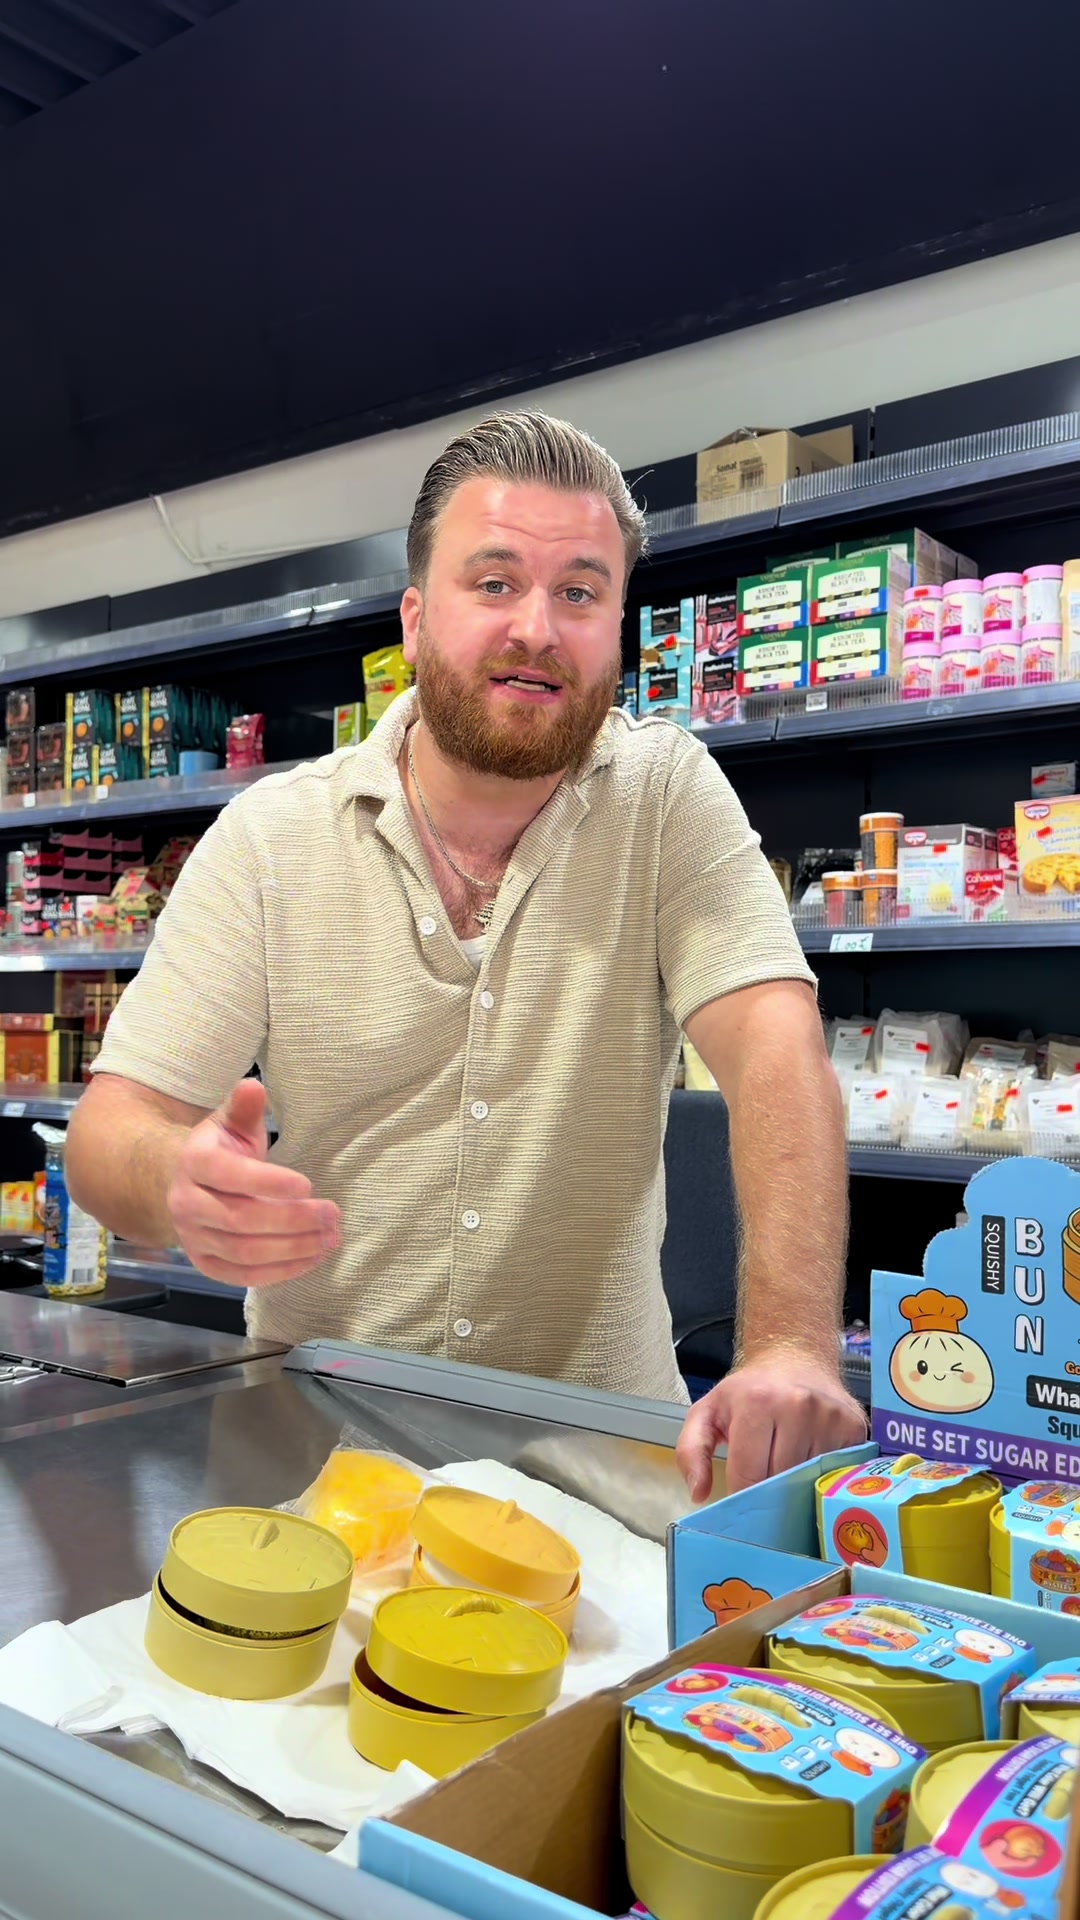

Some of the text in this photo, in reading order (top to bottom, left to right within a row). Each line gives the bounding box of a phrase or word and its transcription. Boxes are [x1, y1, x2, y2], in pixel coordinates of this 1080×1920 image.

[985, 1222, 1001, 1291] SQUISHY
[886, 1420, 926, 1449] ONE
[931, 1430, 970, 1456] SET
[975, 1438, 1049, 1473] SUGAR
[783, 1681, 835, 1707] EDITION
[828, 1699, 870, 1725] SUGAR
[865, 1719, 893, 1738] SET
[889, 1732, 919, 1756] ONE
